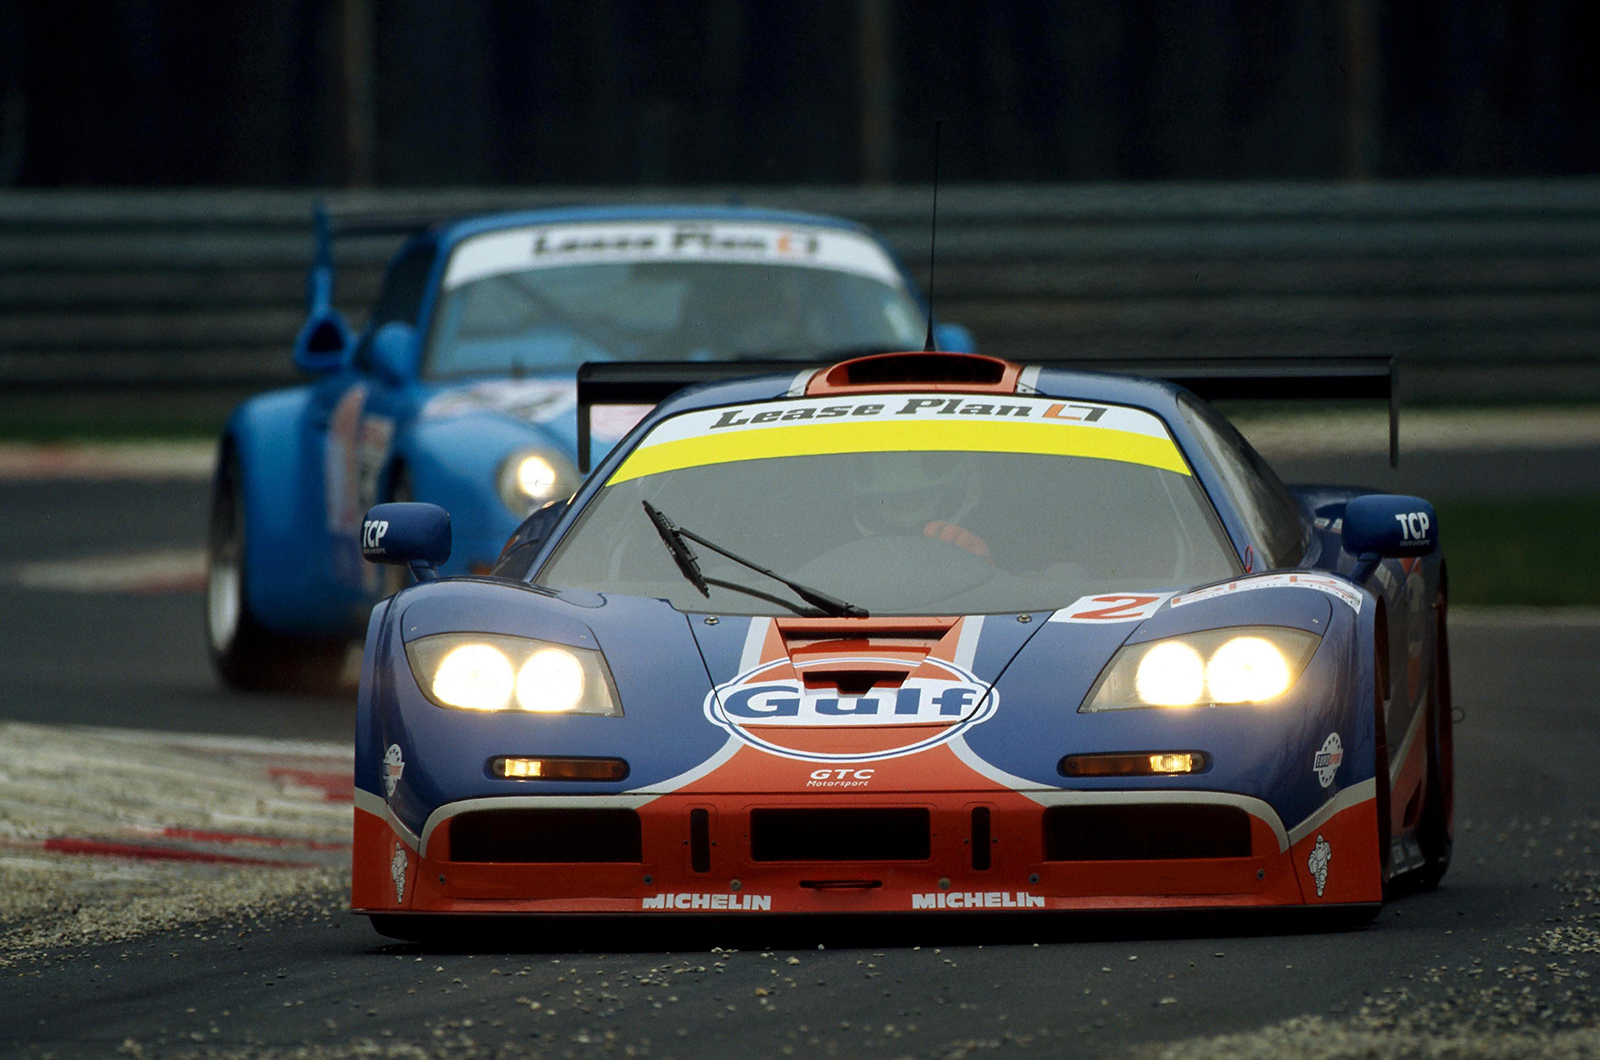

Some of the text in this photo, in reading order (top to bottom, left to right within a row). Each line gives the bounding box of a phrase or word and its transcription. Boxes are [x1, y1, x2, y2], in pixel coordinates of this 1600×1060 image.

[709, 398, 1031, 429] Lease Plan
[363, 520, 389, 548] TCP
[1395, 511, 1430, 540] TCP
[1070, 596, 1160, 619] 2
[723, 686, 977, 719] Gulf
[806, 780, 869, 788] Motorsport
[810, 769, 875, 780] GTC
[642, 893, 771, 911] MICHELIN
[912, 892, 1045, 909] MICHELIN
